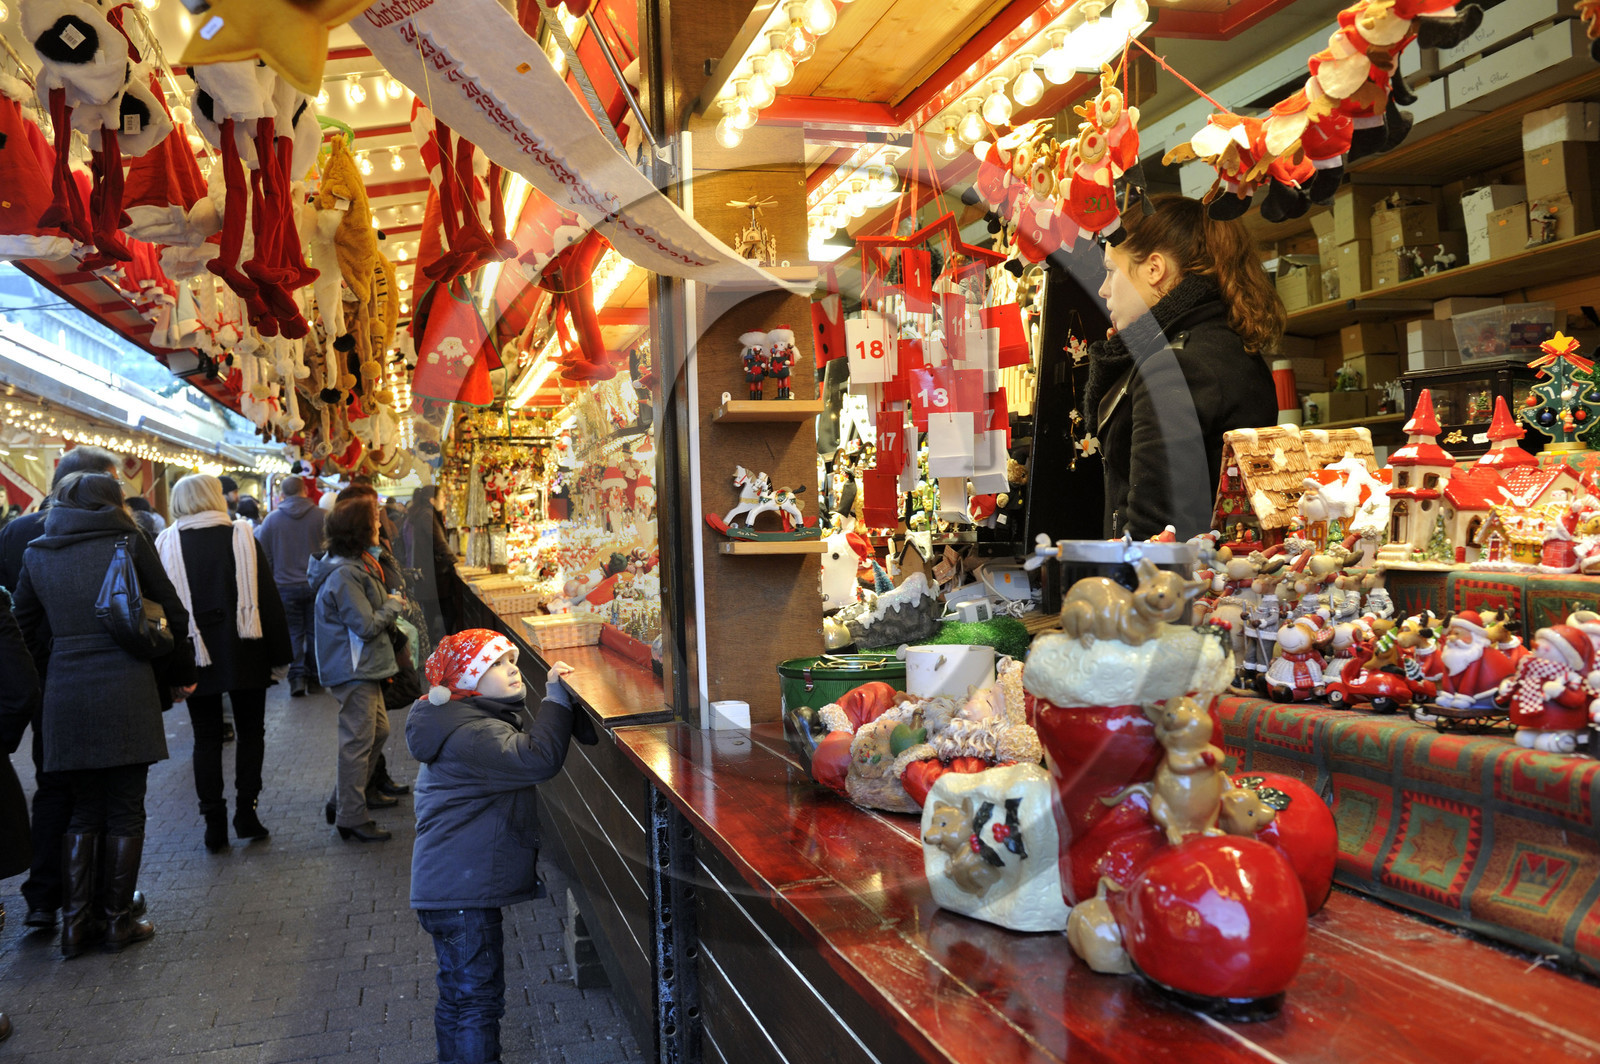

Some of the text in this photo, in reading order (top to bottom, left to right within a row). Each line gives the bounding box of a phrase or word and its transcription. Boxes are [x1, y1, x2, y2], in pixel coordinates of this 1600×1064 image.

[400, 22, 419, 43] 24
[416, 39, 435, 58] 23
[432, 52, 452, 69] 22
[446, 70, 464, 82] 21
[462, 81, 480, 98] 20
[476, 95, 494, 110] 19
[488, 108, 508, 123] 18
[500, 120, 518, 132] 17
[514, 133, 534, 145] 16
[523, 144, 543, 154] 15
[535, 153, 555, 165] 14
[550, 164, 569, 176] 13
[558, 175, 580, 185] 12
[1084, 194, 1109, 213] 20
[1032, 230, 1043, 246] 9
[657, 242, 669, 251] 4
[682, 255, 693, 263] 2
[914, 268, 921, 287] 1
[952, 315, 963, 337] 11
[855, 340, 885, 360] 18
[917, 388, 949, 408] 13
[879, 432, 897, 451] 17
